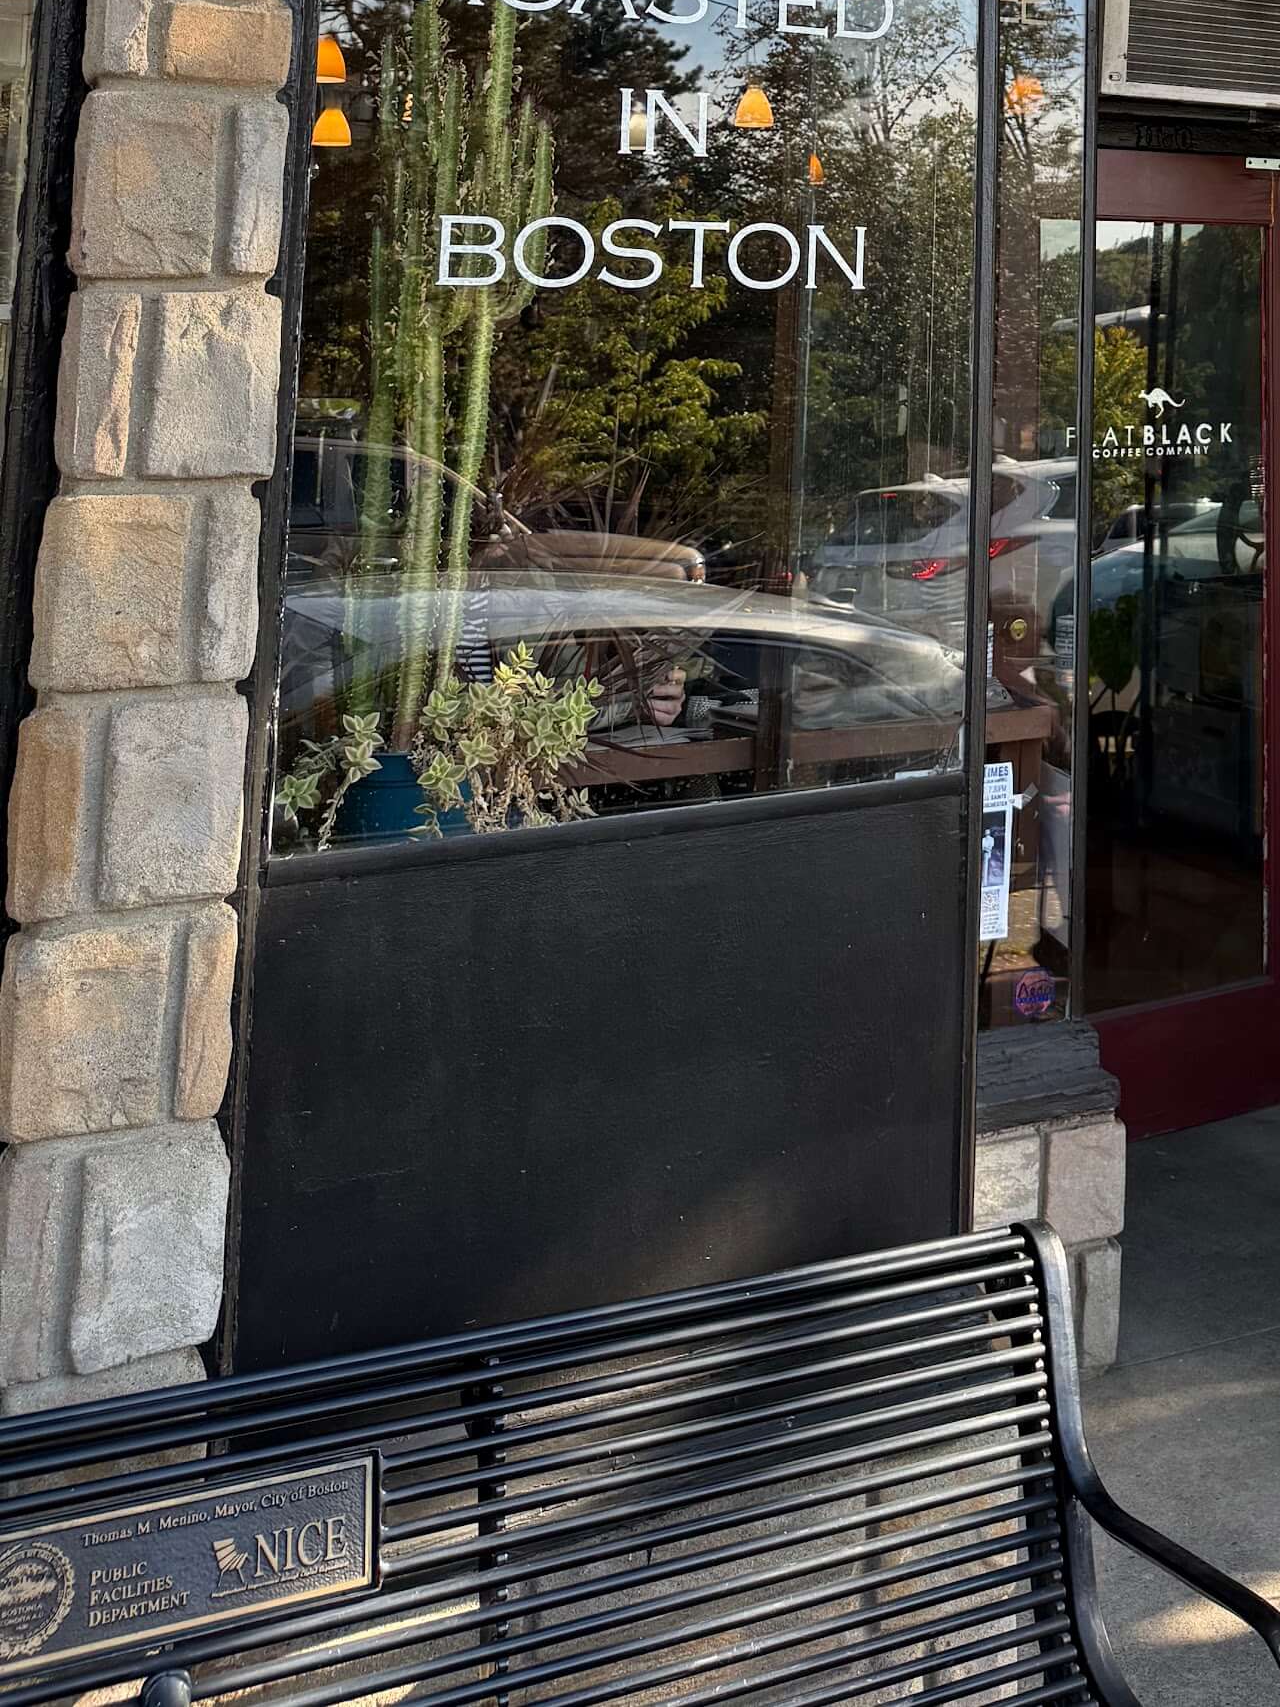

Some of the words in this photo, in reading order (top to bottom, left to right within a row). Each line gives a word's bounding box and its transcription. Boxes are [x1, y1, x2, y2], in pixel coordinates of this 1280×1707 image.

[618, 88, 710, 157] IN
[435, 215, 868, 291] BOSTON
[1092, 447, 1141, 459] COFFEE
[1146, 445, 1209, 457] COMPANY
[81, 1527, 133, 1547] Thomas
[137, 1522, 155, 1536] M.
[159, 1510, 211, 1531] Menino,
[214, 1500, 257, 1519] Mayor,
[261, 1491, 287, 1510] City
[290, 1487, 304, 1502] of
[308, 1480, 349, 1499] Boston
[254, 1514, 349, 1579] NICE
[89, 1575, 174, 1607] FACILITIES
[90, 1561, 148, 1587] PUBLIC
[87, 1590, 191, 1628] DEPARTMENT
